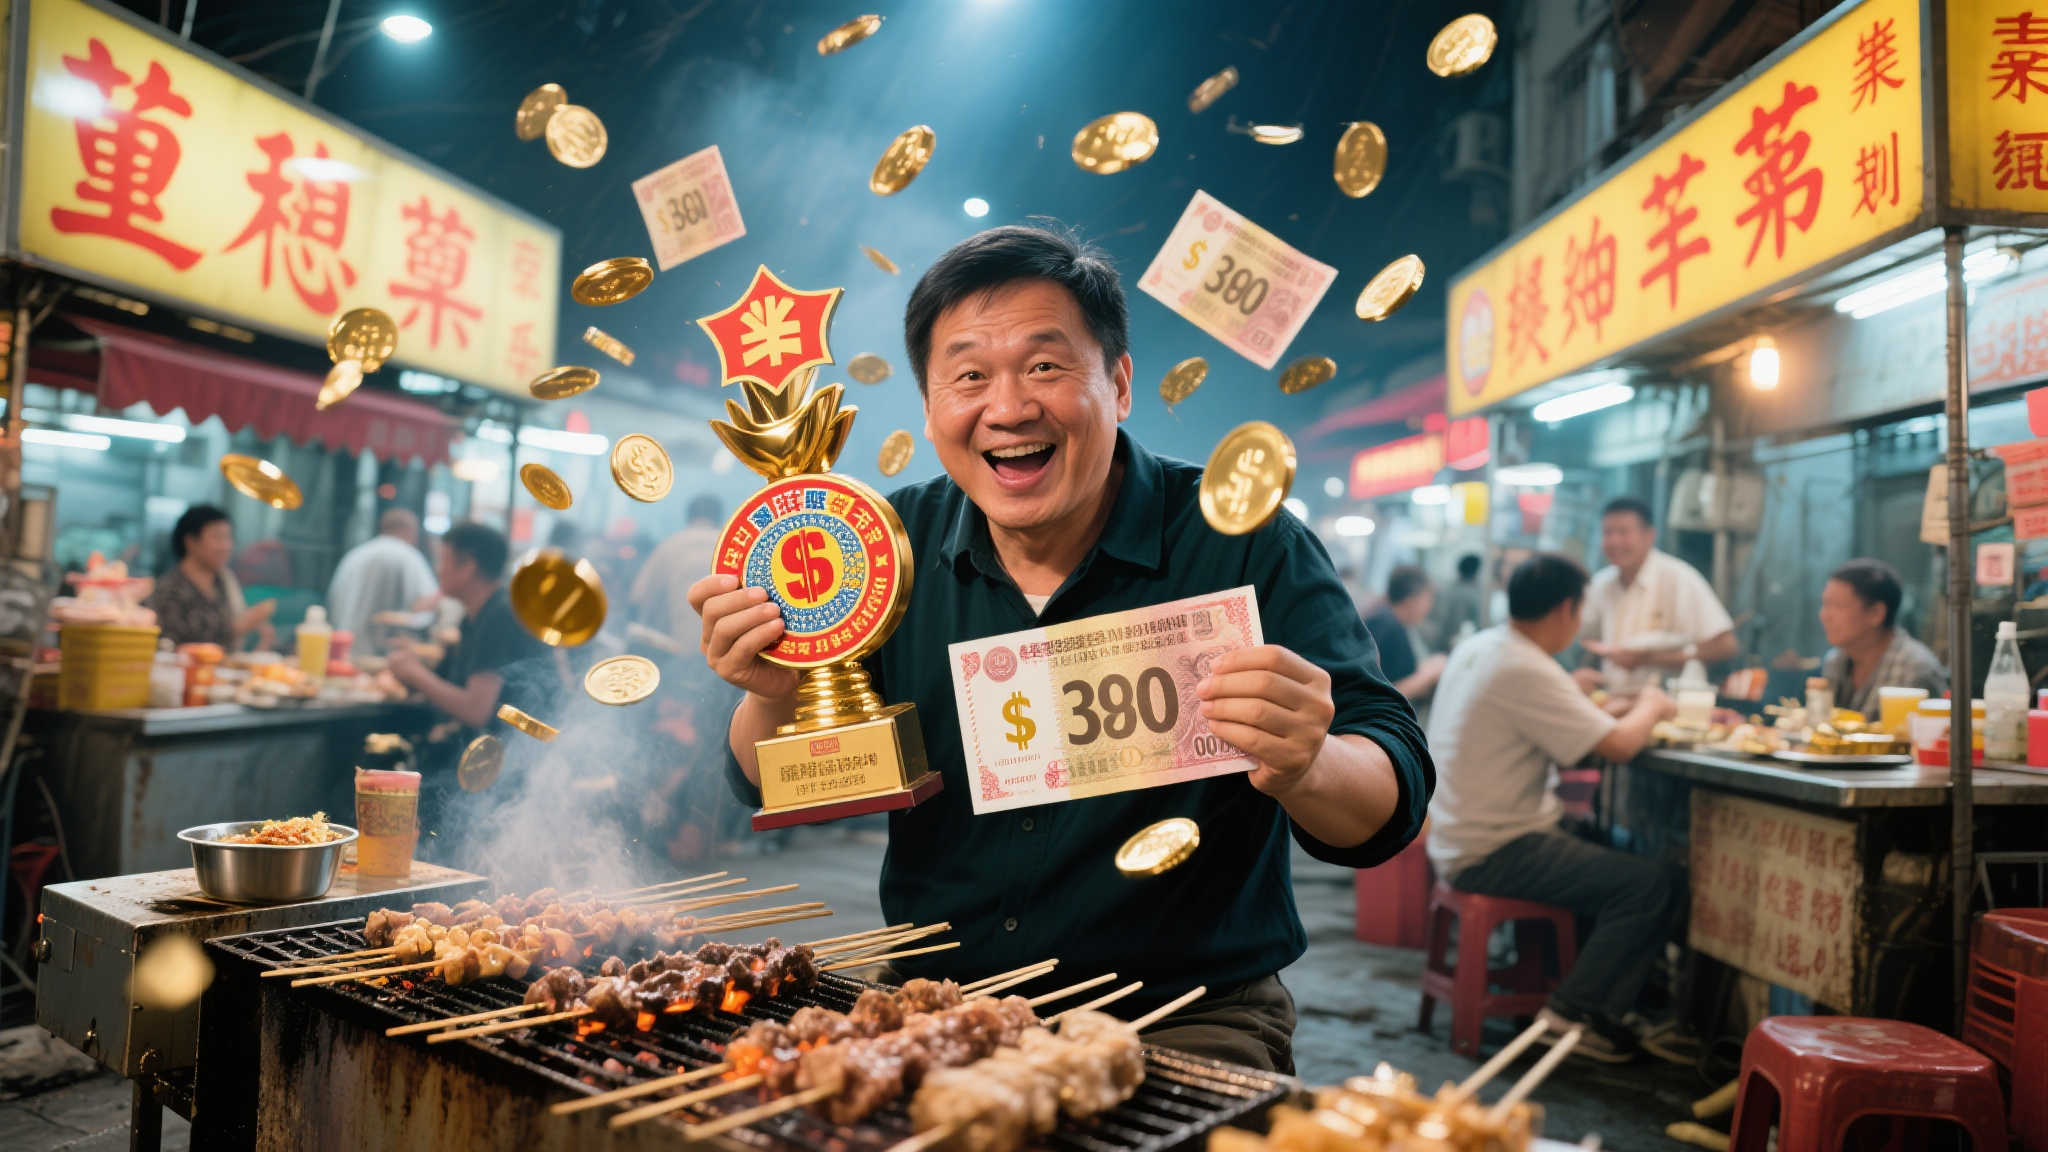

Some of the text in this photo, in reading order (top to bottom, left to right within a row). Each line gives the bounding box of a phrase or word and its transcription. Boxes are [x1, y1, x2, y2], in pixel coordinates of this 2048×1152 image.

[1203, 255, 1270, 316] 380
[780, 528, 834, 603] $
[1001, 666, 1180, 751] $ 380
